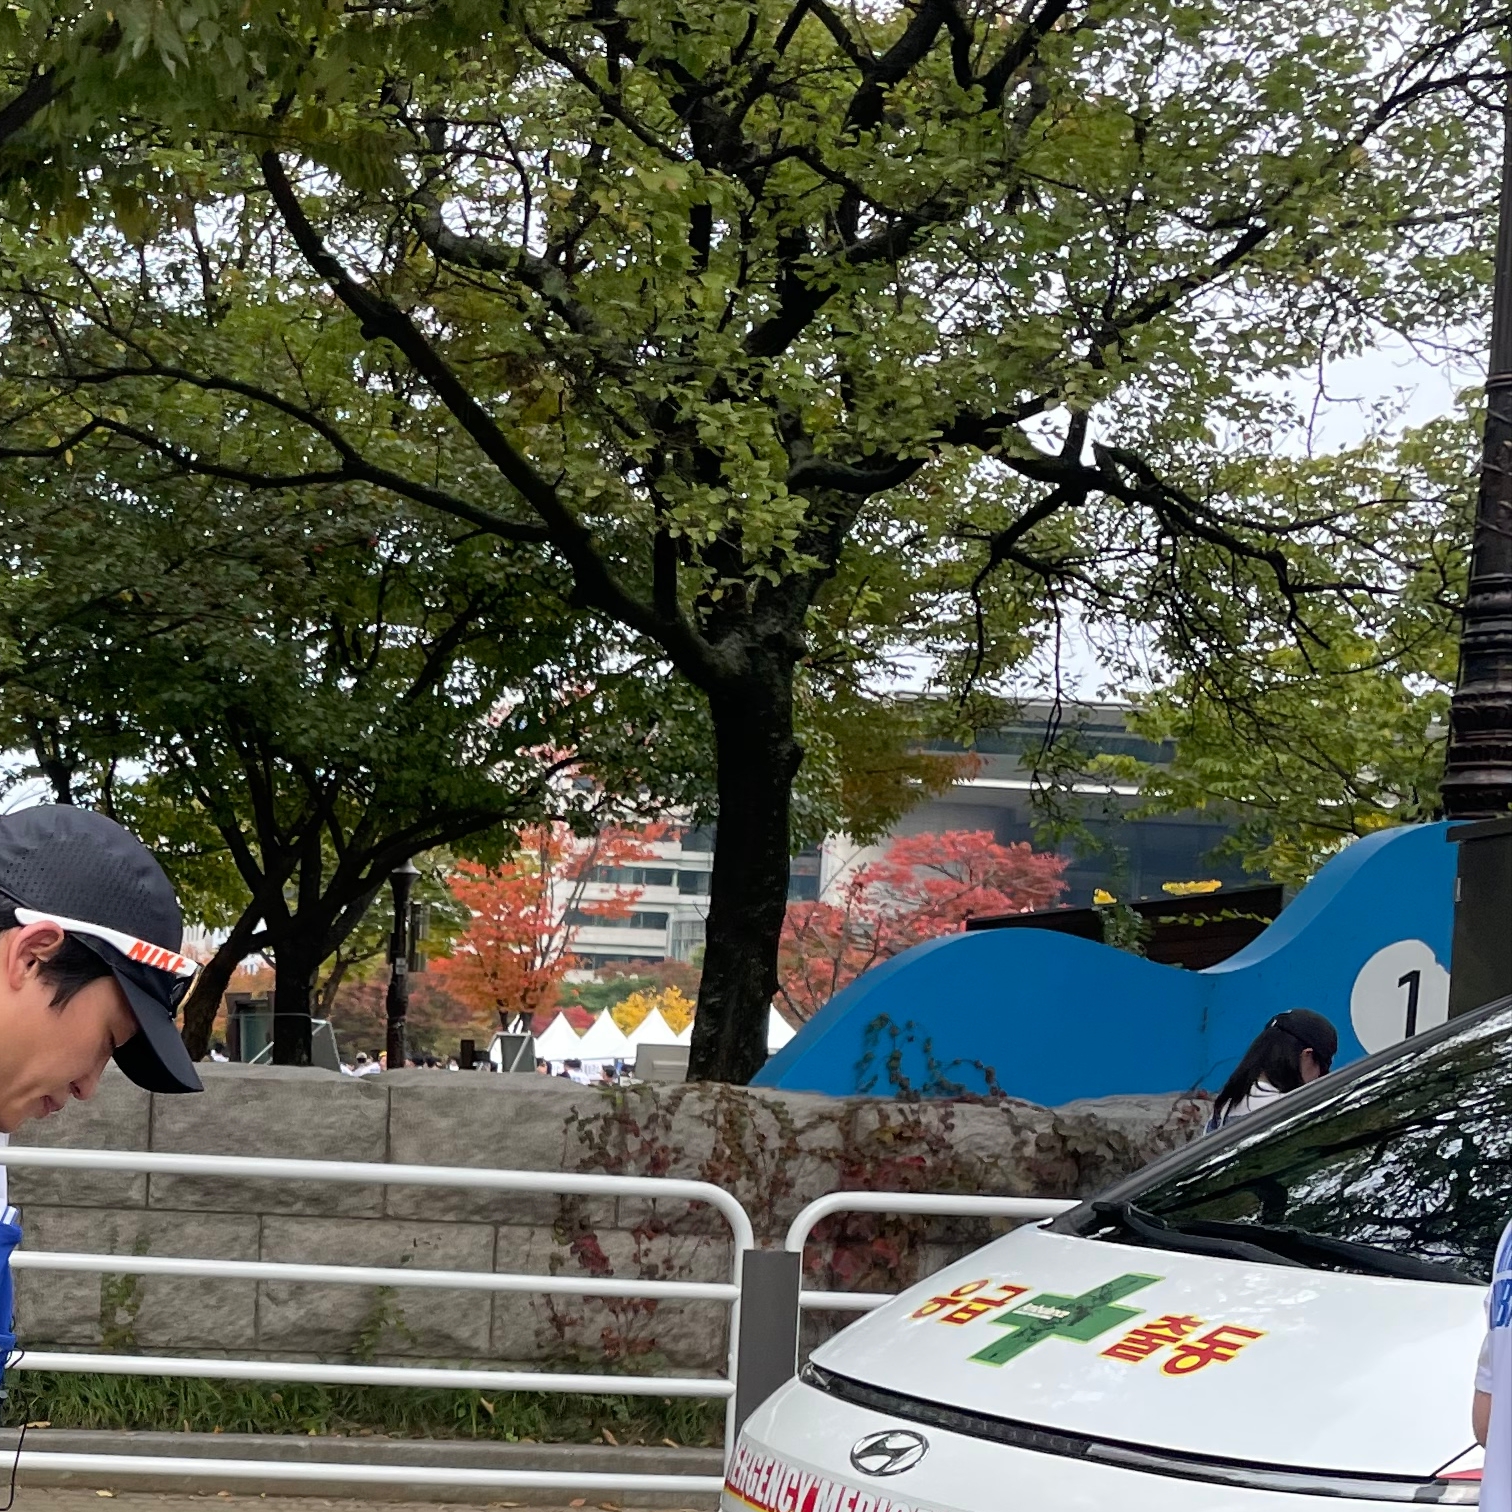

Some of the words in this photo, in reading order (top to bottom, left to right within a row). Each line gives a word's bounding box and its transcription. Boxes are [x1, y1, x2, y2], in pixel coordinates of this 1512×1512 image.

[129, 941, 186, 973] NIKE
[1397, 969, 1421, 1039] 1
[911, 1278, 1031, 1325] 응급
[1099, 1314, 1266, 1376] 출동
